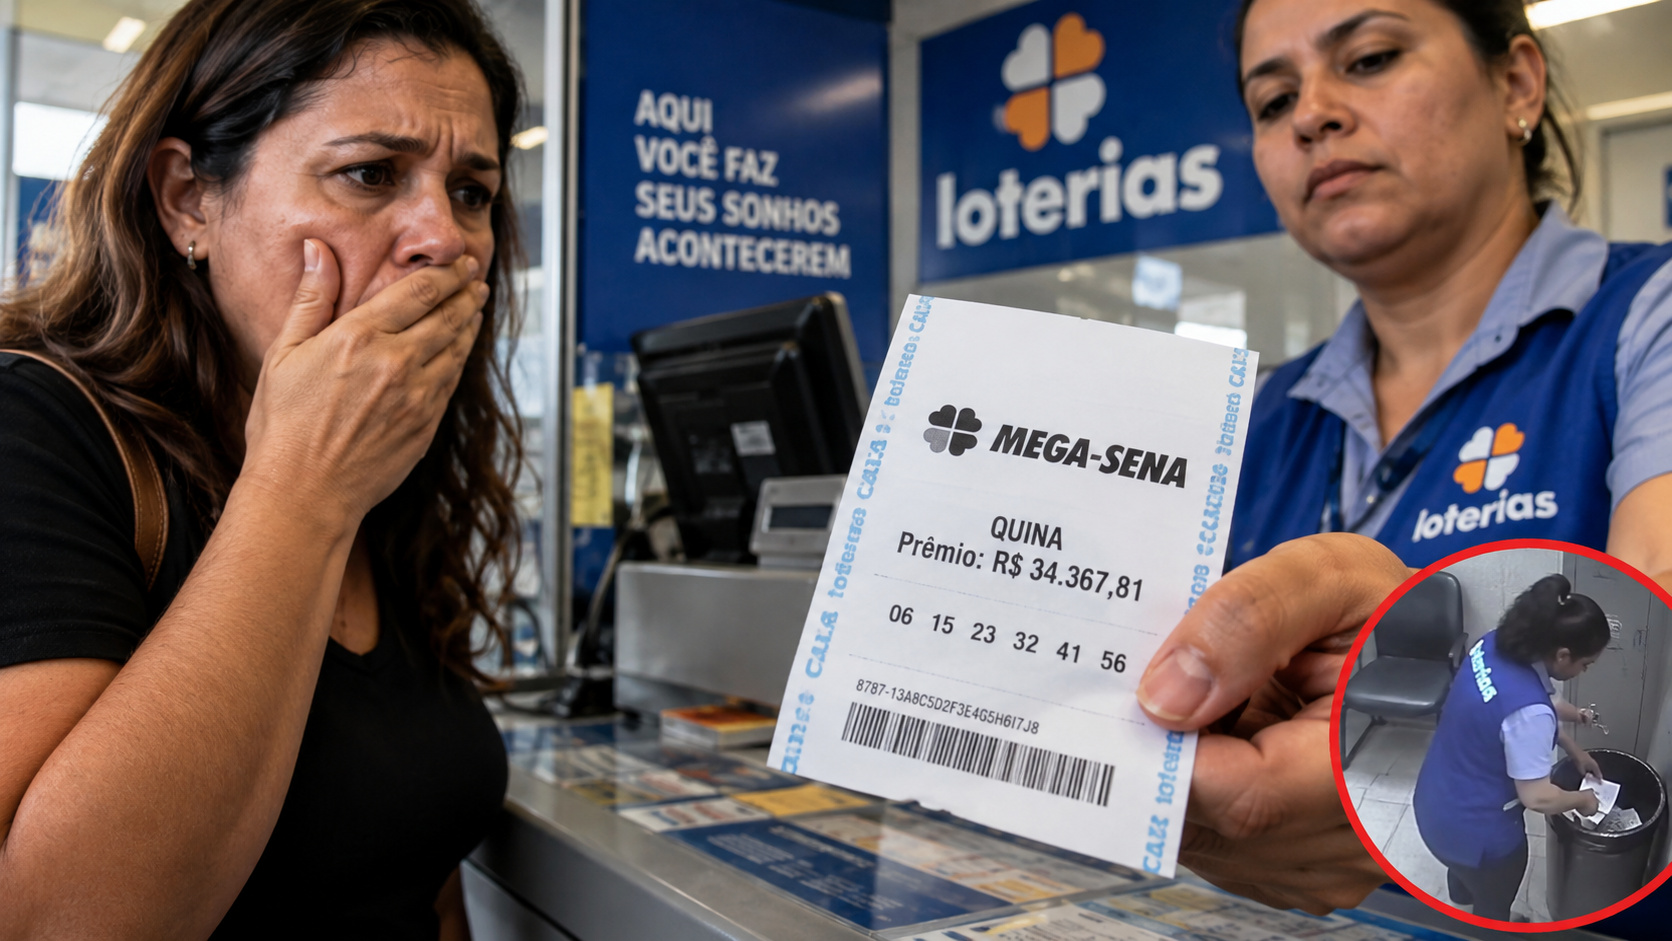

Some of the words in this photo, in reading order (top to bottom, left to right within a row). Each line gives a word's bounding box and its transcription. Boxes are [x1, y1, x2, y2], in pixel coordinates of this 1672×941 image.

[636, 91, 713, 134] AQUI
[636, 137, 718, 180] VOCÊ
[725, 149, 779, 187] FAZ
[636, 183, 716, 222] SEUS
[723, 193, 840, 236] SONHOS
[937, 137, 1222, 249] loterias
[635, 228, 850, 278] ACONTECEREM
[989, 424, 1188, 489] MEGA-SENA
[991, 515, 1063, 551] QUINA
[1411, 488, 1558, 543] loterias
[897, 531, 985, 570] Prêmio:
[992, 550, 1024, 580] R$
[1029, 558, 1144, 603] 34.367,81
[888, 604, 914, 626] 06
[931, 614, 955, 635] 15
[970, 622, 997, 644] 23
[1013, 631, 1040, 654] 32
[1056, 641, 1082, 663] 41
[1100, 650, 1127, 674] 56
